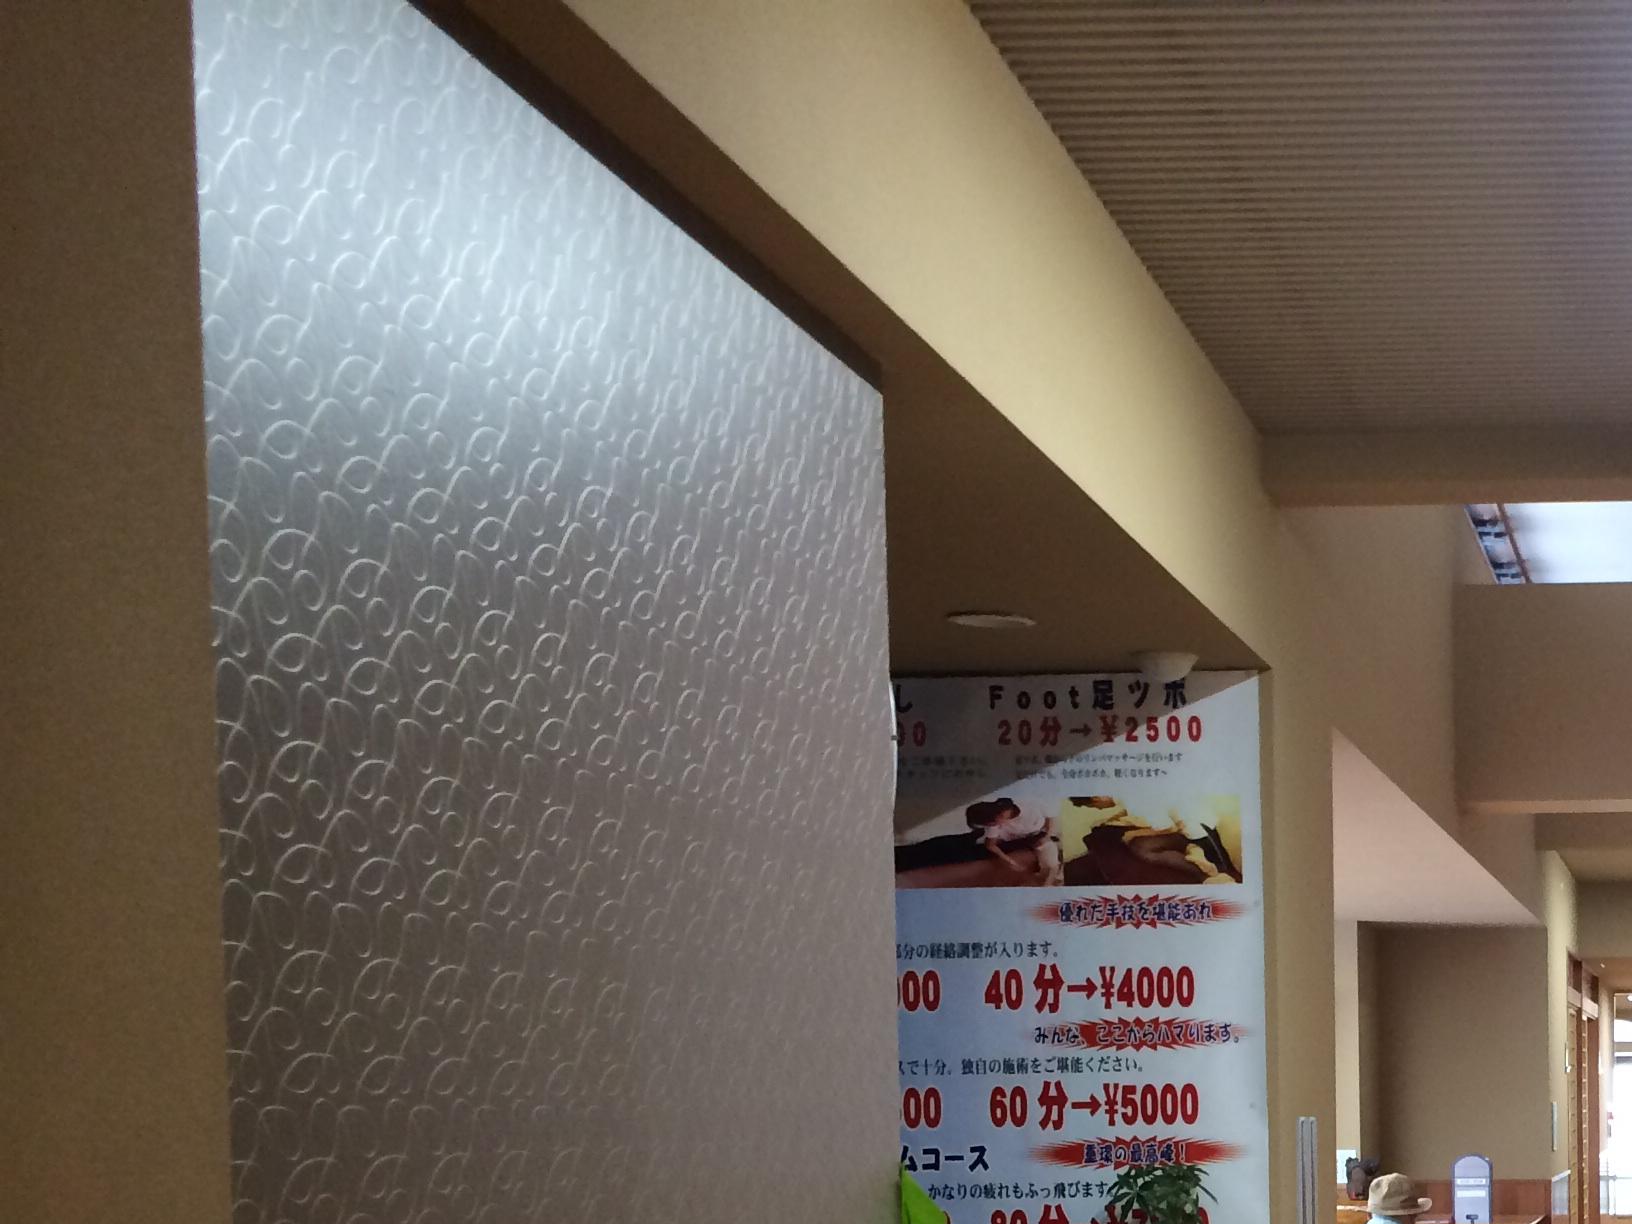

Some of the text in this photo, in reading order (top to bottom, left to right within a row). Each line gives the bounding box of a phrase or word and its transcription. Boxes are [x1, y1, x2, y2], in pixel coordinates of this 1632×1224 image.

[1059, 901, 1213, 922] 優れた手技を堪能あれ
[897, 969, 942, 1012] 00
